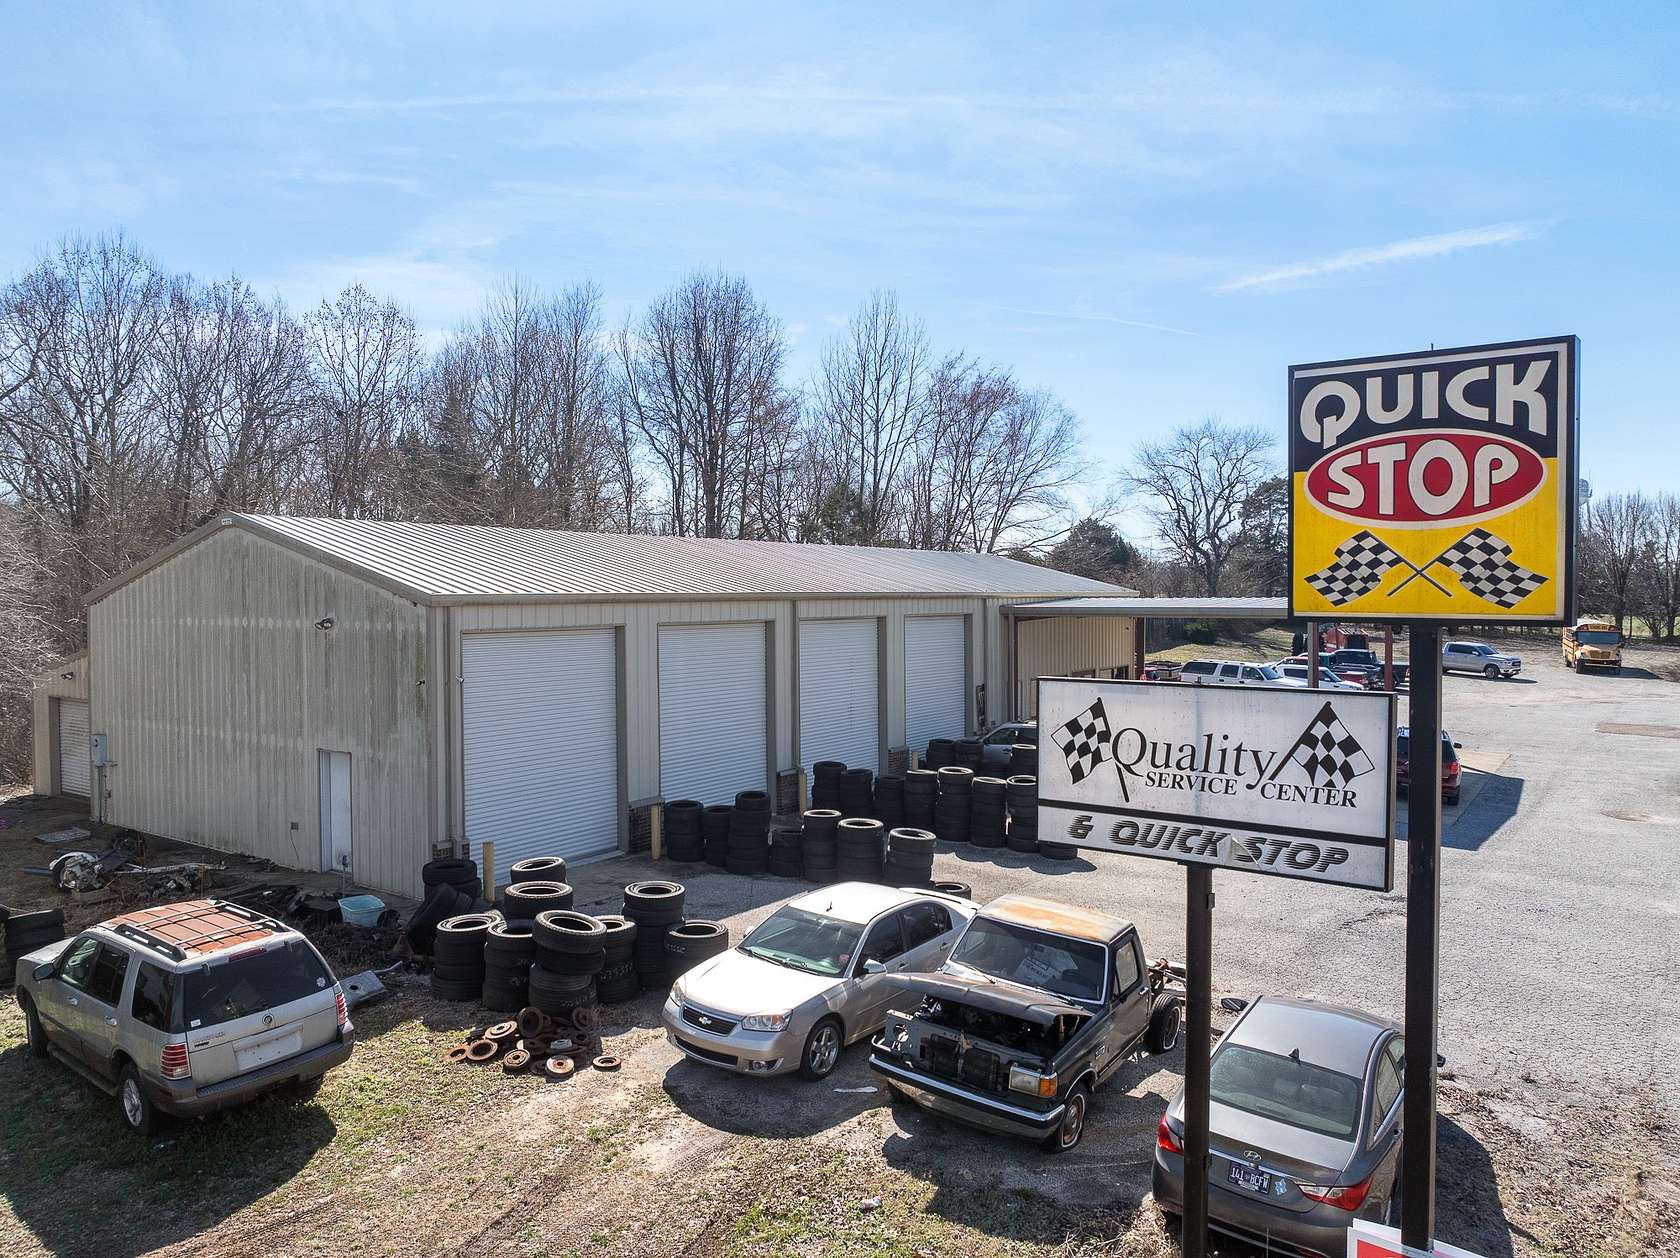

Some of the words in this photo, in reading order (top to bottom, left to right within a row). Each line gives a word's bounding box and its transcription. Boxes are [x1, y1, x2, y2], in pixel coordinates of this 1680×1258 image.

[1299, 359, 1552, 450] QUICK
[1327, 438, 1520, 516] STOP
[1111, 727, 1277, 790] Quality
[1144, 771, 1238, 796] SERVICE
[1260, 782, 1358, 808] CENTER
[1067, 815, 1095, 840] &
[1108, 819, 1231, 858] QUICK
[1232, 836, 1350, 873] STOP
